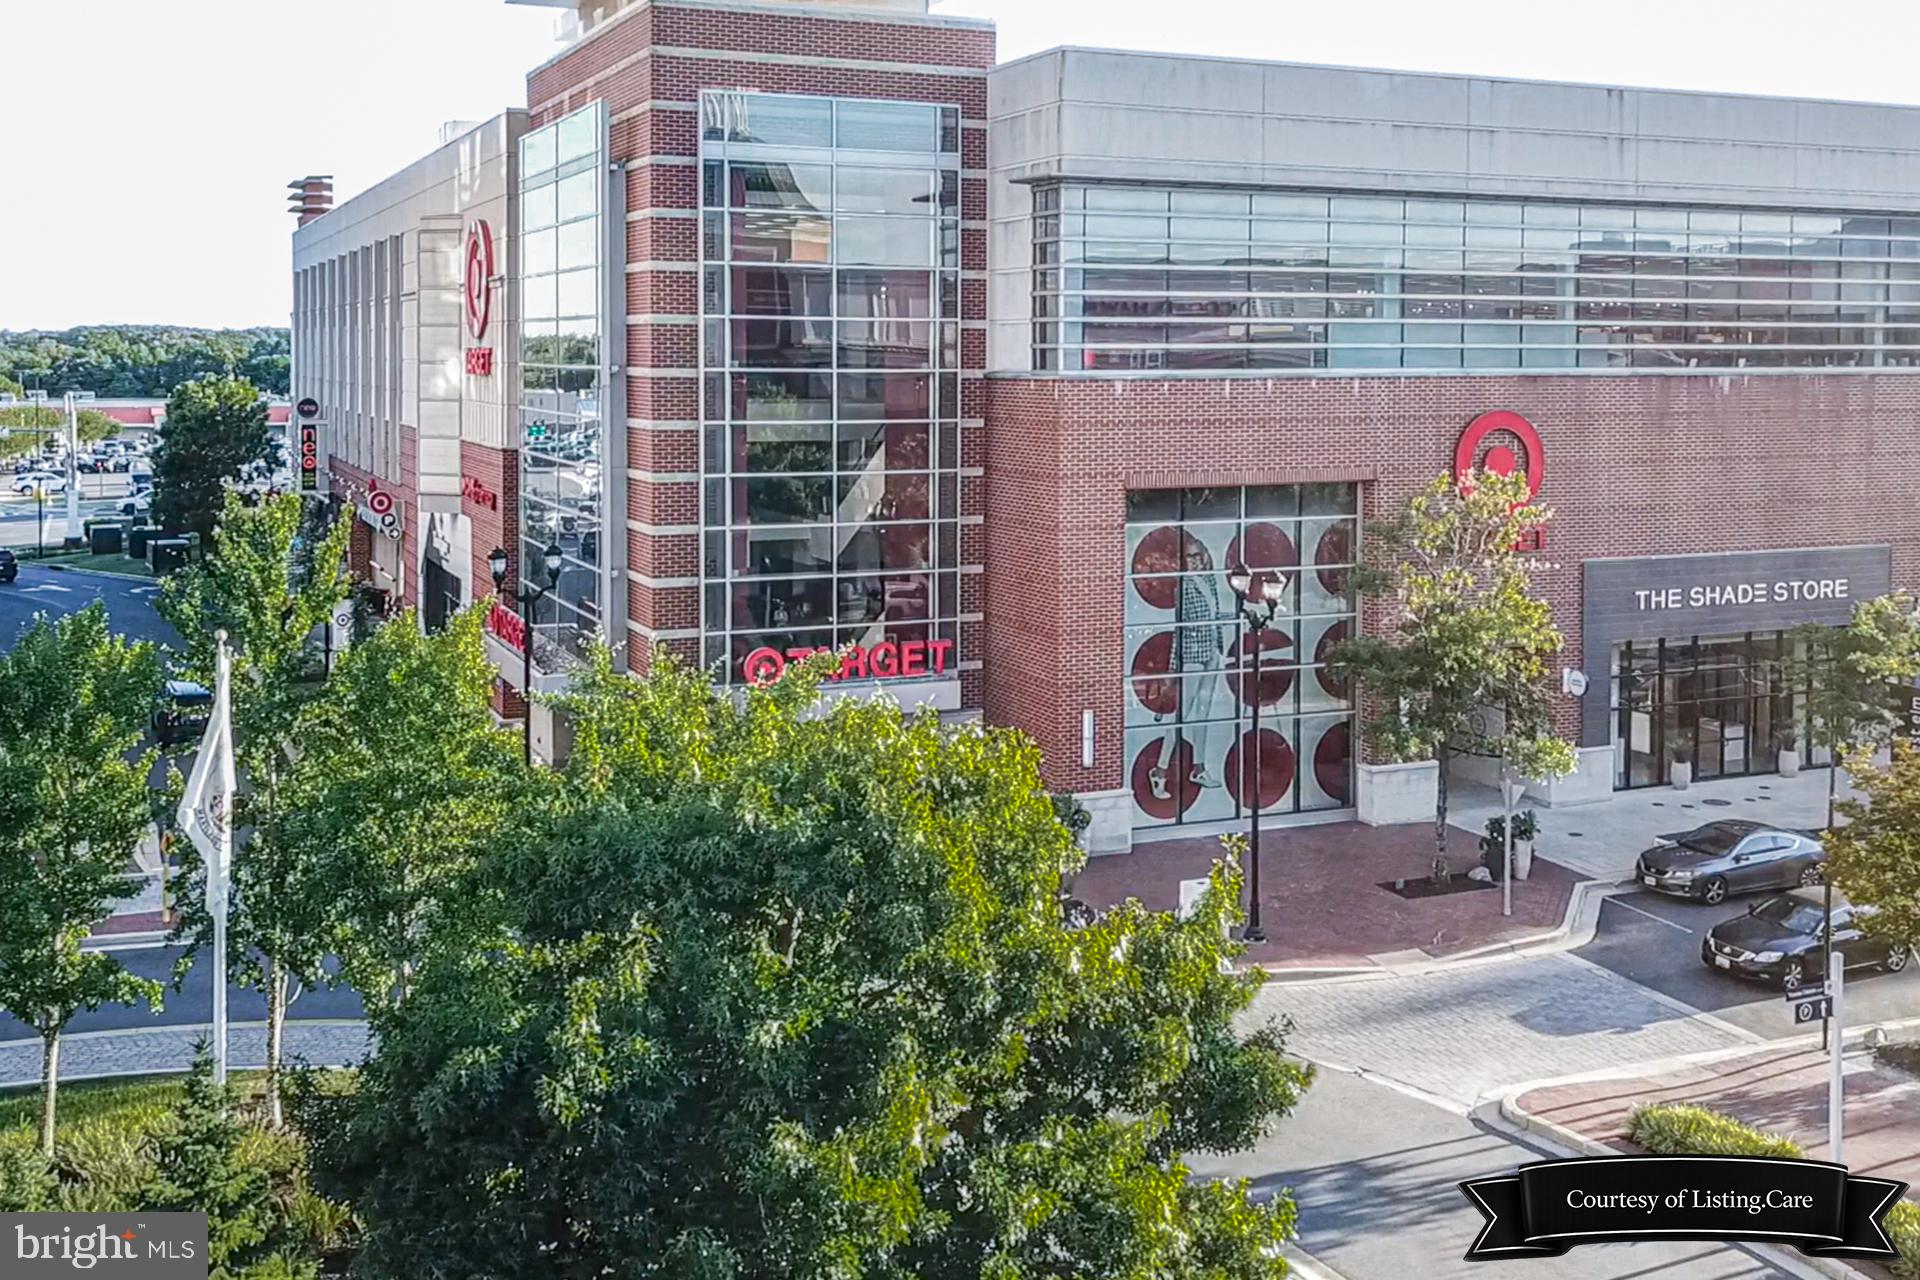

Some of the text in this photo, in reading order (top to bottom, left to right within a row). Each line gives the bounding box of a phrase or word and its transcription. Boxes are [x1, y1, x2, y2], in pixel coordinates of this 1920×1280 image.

[1634, 579, 1849, 611] THE SHADE STORE
[786, 638, 952, 680] TRGET
